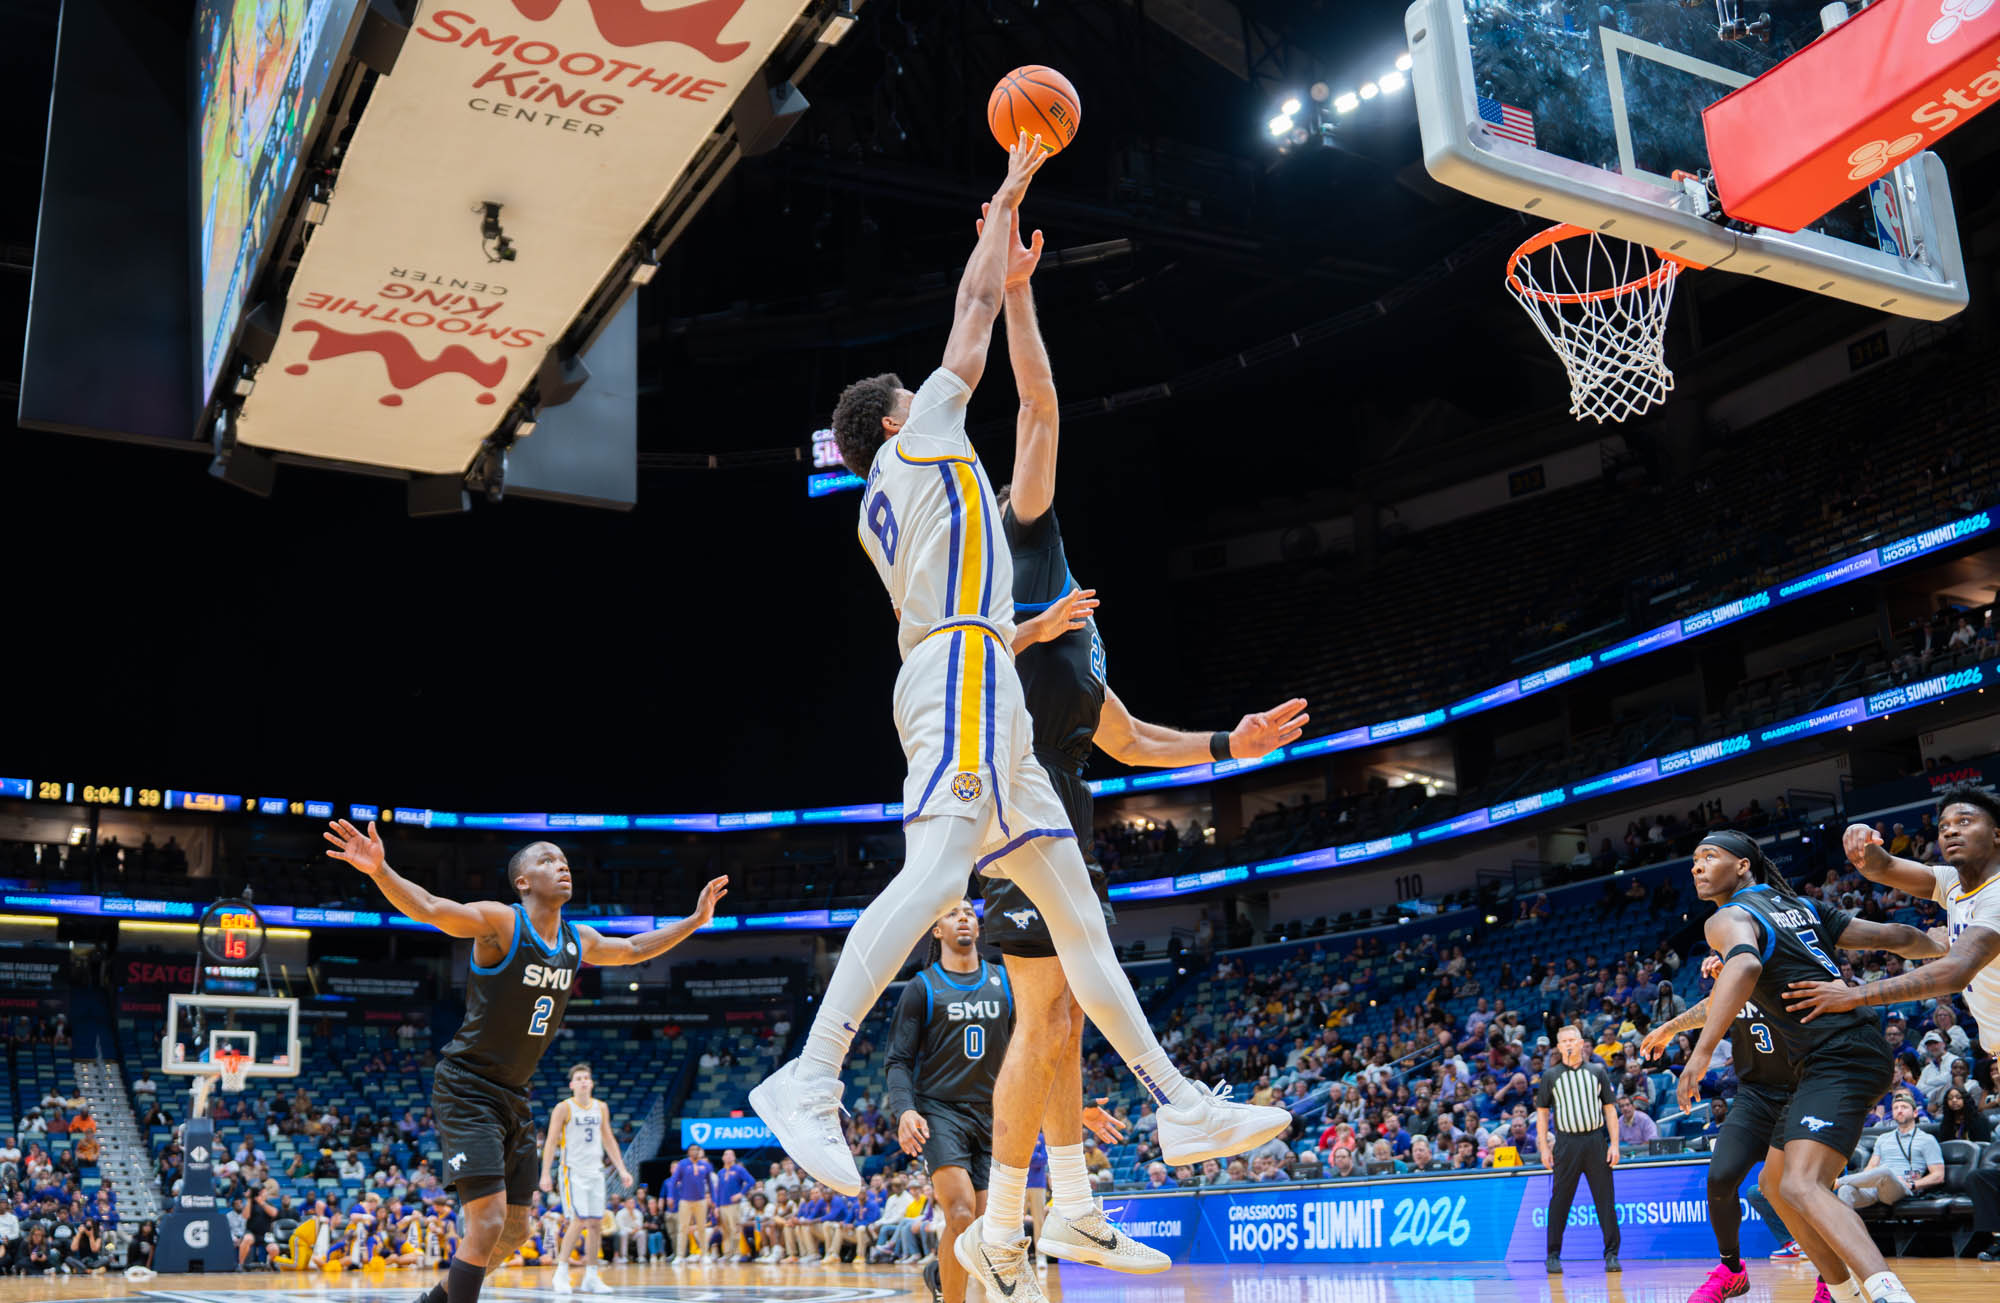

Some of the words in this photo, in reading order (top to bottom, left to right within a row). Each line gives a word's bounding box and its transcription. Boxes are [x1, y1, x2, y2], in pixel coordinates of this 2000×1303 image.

[416, 11, 727, 102] SMOOTHIE
[1913, 54, 2000, 131] Sta
[468, 98, 605, 136] CENTER
[389, 267, 508, 296] CENTER
[297, 292, 545, 348] SMOOTHIE
[867, 490, 898, 566] 8
[1883, 543, 1918, 562] HOOPS
[1917, 523, 1957, 551] SUMMIT
[1955, 512, 1990, 538] 2026
[1684, 617, 1712, 633] HOOPS
[1712, 600, 1743, 623] SUMMIT
[1870, 694, 1906, 713] HOOPS
[1906, 676, 1947, 702] SUMMIT
[1945, 667, 1983, 692] 2026
[1661, 757, 1690, 772] HOOPS
[1690, 742, 1723, 764] SUMMIT
[1721, 734, 1751, 757] 2026
[39, 782, 61, 800] 28
[83, 786, 120, 803] 6:04
[138, 789, 160, 807] 39
[183, 793, 225, 811] LSU
[1395, 873, 1424, 900] 110
[220, 913, 257, 930] 6:04
[1795, 928, 1841, 977] 5
[522, 964, 573, 990] SMU
[528, 995, 555, 1036] 2
[947, 1001, 1000, 1021] SMU
[964, 1024, 985, 1060] 0
[1750, 1023, 1774, 1054] 3
[575, 1116, 601, 1126] LSU
[584, 1127, 593, 1142] 3
[1228, 1203, 1298, 1222] GRASSROOTS
[1229, 1222, 1299, 1251] HOOPS
[1302, 1199, 1384, 1250] SUMMIT
[1389, 1195, 1471, 1247] 2026
